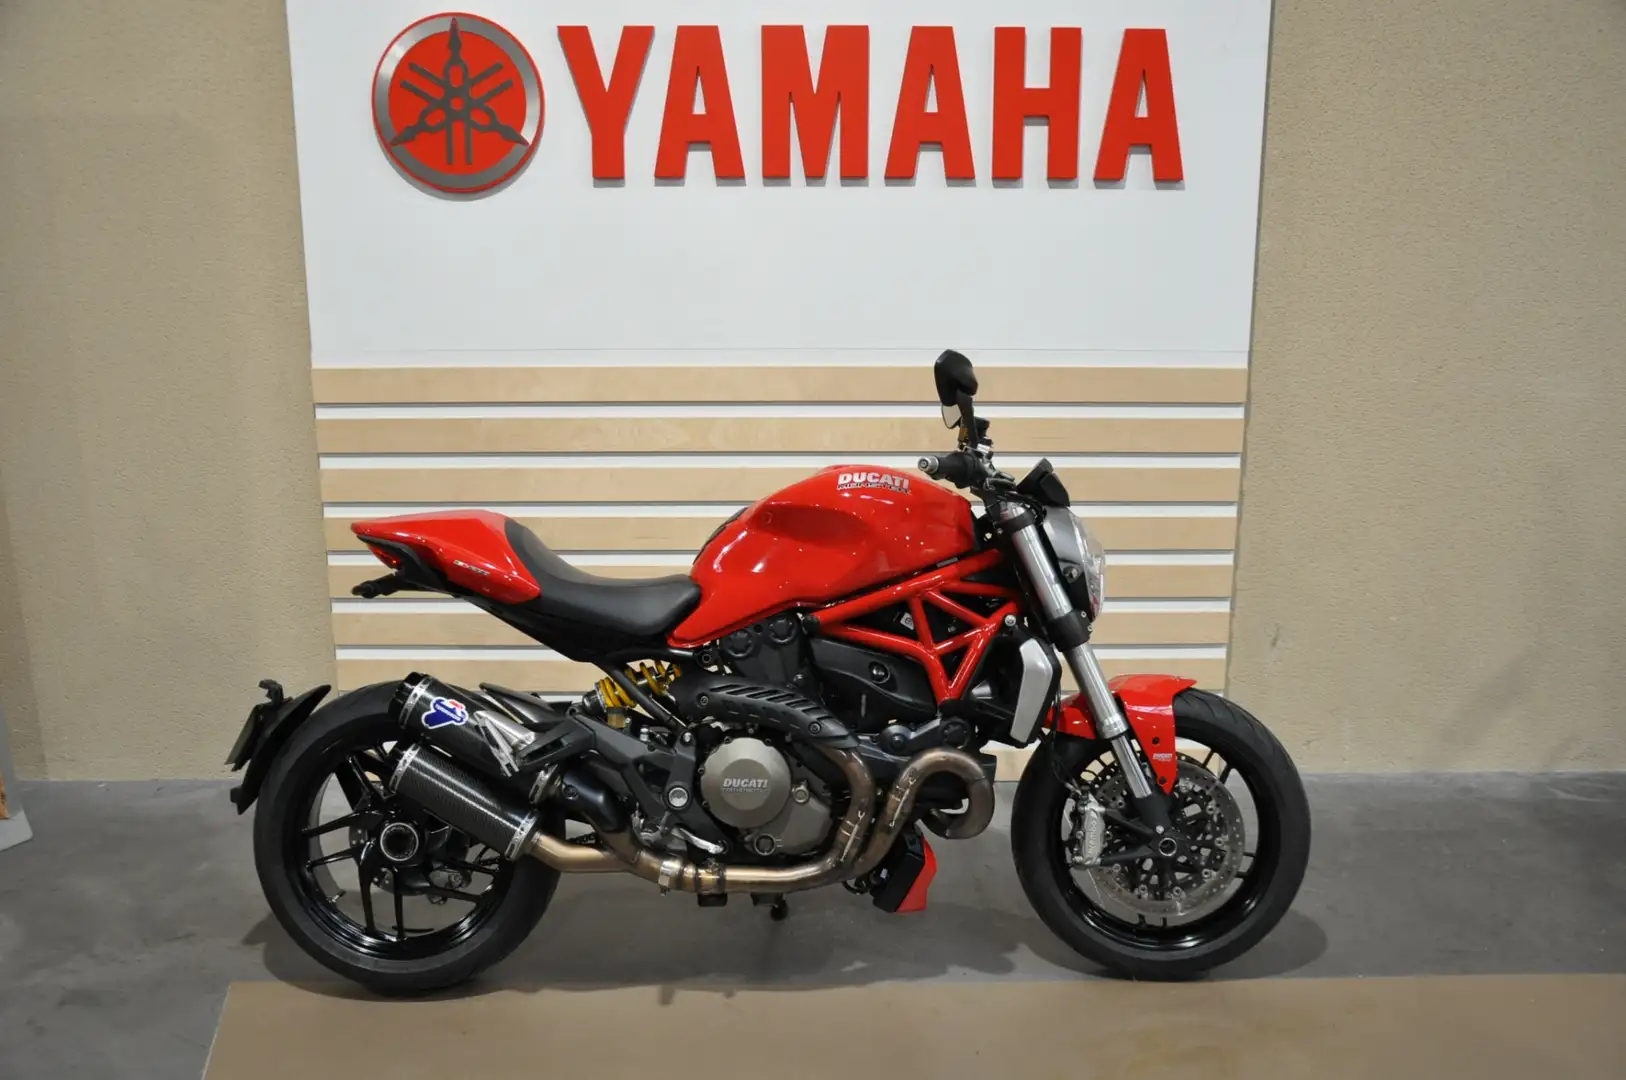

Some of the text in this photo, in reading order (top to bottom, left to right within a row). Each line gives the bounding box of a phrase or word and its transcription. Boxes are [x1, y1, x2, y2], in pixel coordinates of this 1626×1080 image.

[557, 25, 1183, 185] YAMAHA
[837, 472, 910, 490] DUCATI
[722, 778, 769, 788] DUCATI
